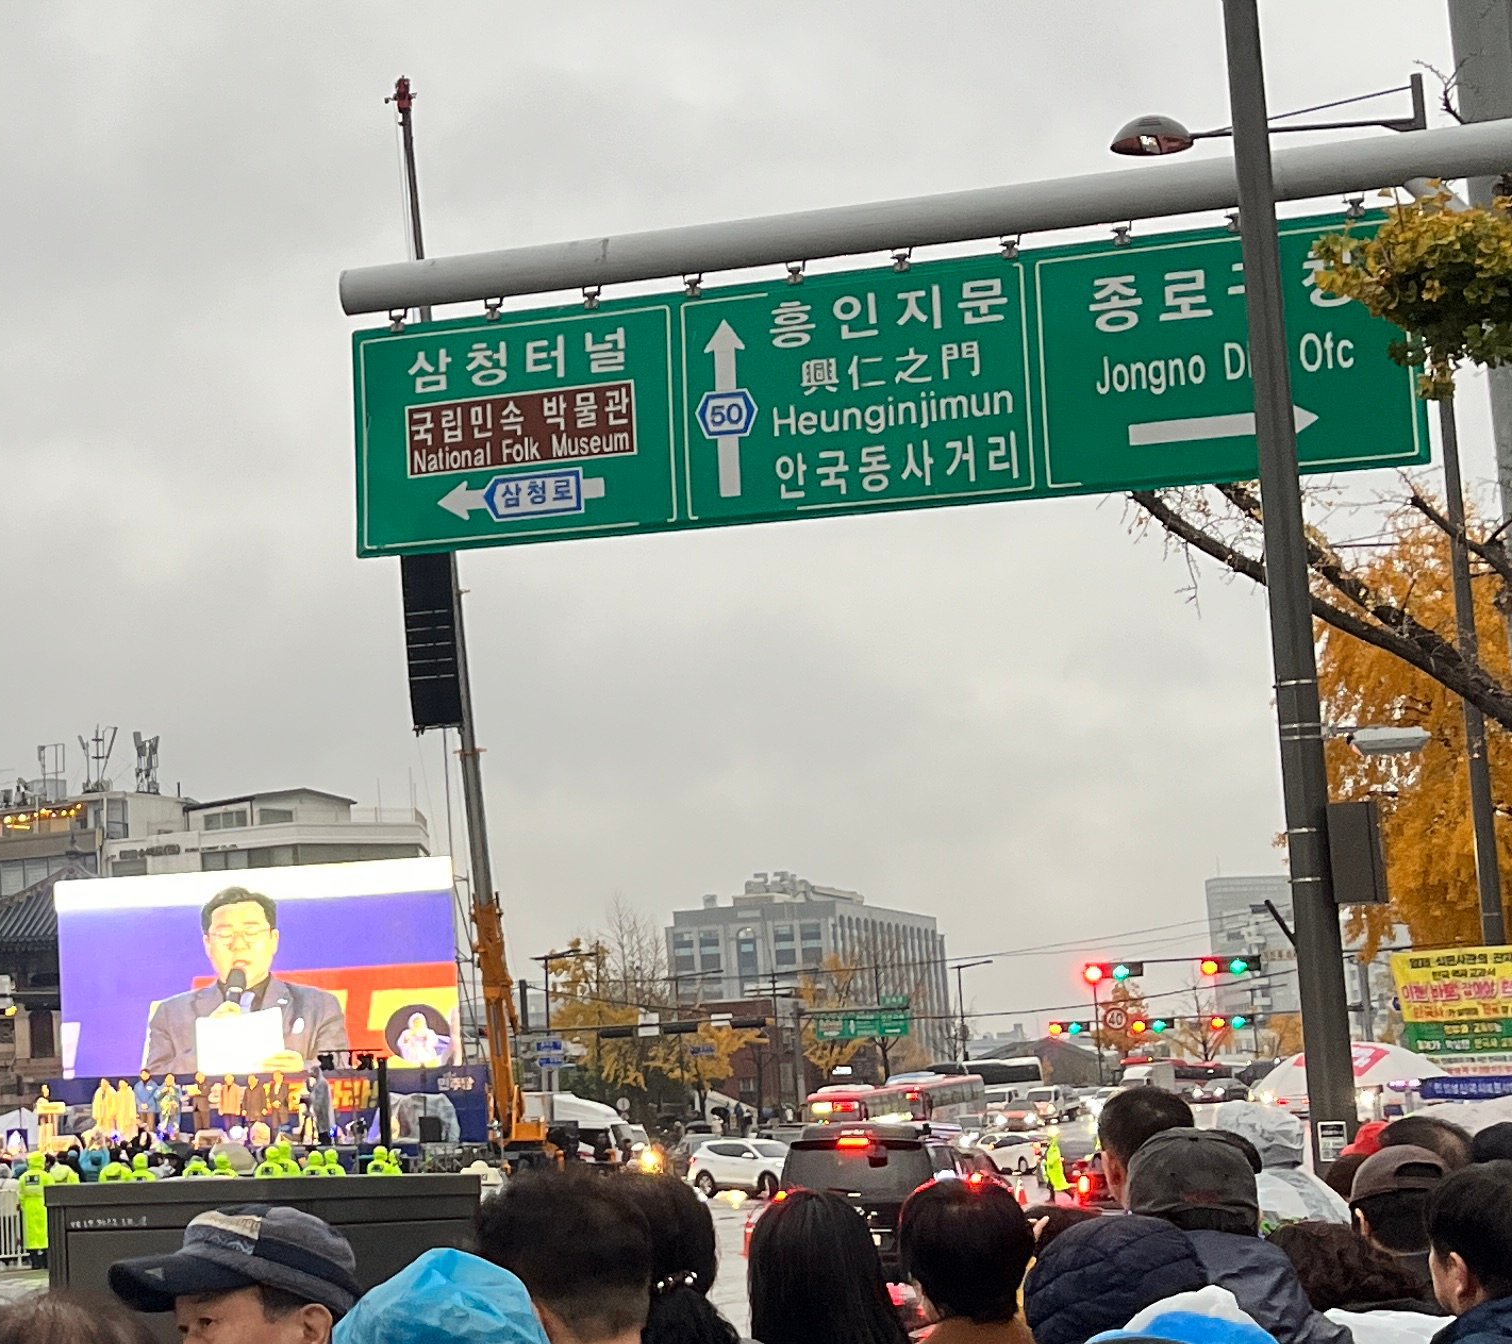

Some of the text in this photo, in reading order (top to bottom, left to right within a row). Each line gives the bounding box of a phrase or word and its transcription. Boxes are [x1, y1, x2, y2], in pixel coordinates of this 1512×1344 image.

[769, 278, 1009, 349] 흥인지문
[407, 326, 628, 394] 삼청터널
[801, 340, 981, 396] 興仁之門
[1096, 354, 1206, 395] Jongno
[1299, 332, 1355, 372] Ofc
[409, 388, 631, 447] 국립민속 박물관
[710, 404, 744, 426] 50
[771, 389, 1014, 437] Heunginjimun
[413, 431, 630, 473] National Folk Museum
[776, 430, 1021, 500] 안국동사거리
[500, 480, 575, 509] 삼청로
[1108, 1011, 1124, 1026] 40
